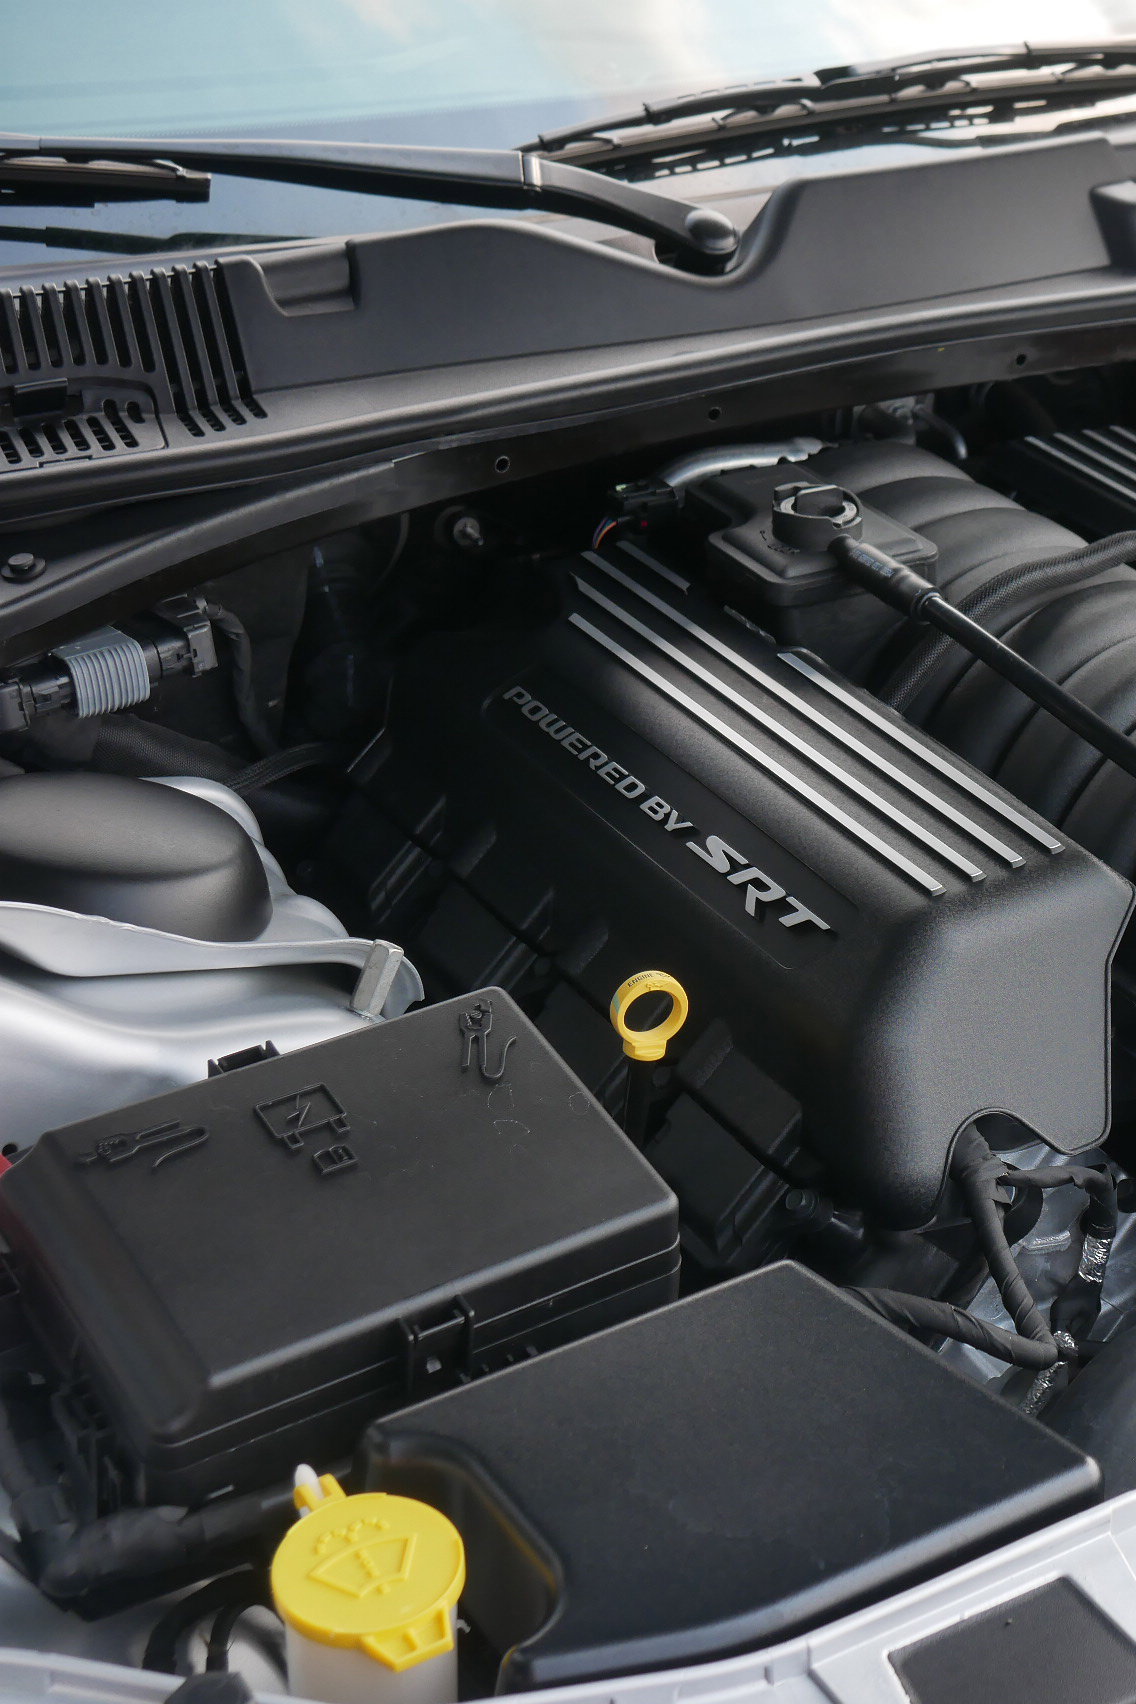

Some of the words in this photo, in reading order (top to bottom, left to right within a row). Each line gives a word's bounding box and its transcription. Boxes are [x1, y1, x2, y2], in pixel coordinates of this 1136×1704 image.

[502, 685, 647, 800] POWERED
[639, 795, 694, 833] BY
[685, 834, 831, 931] SRT
